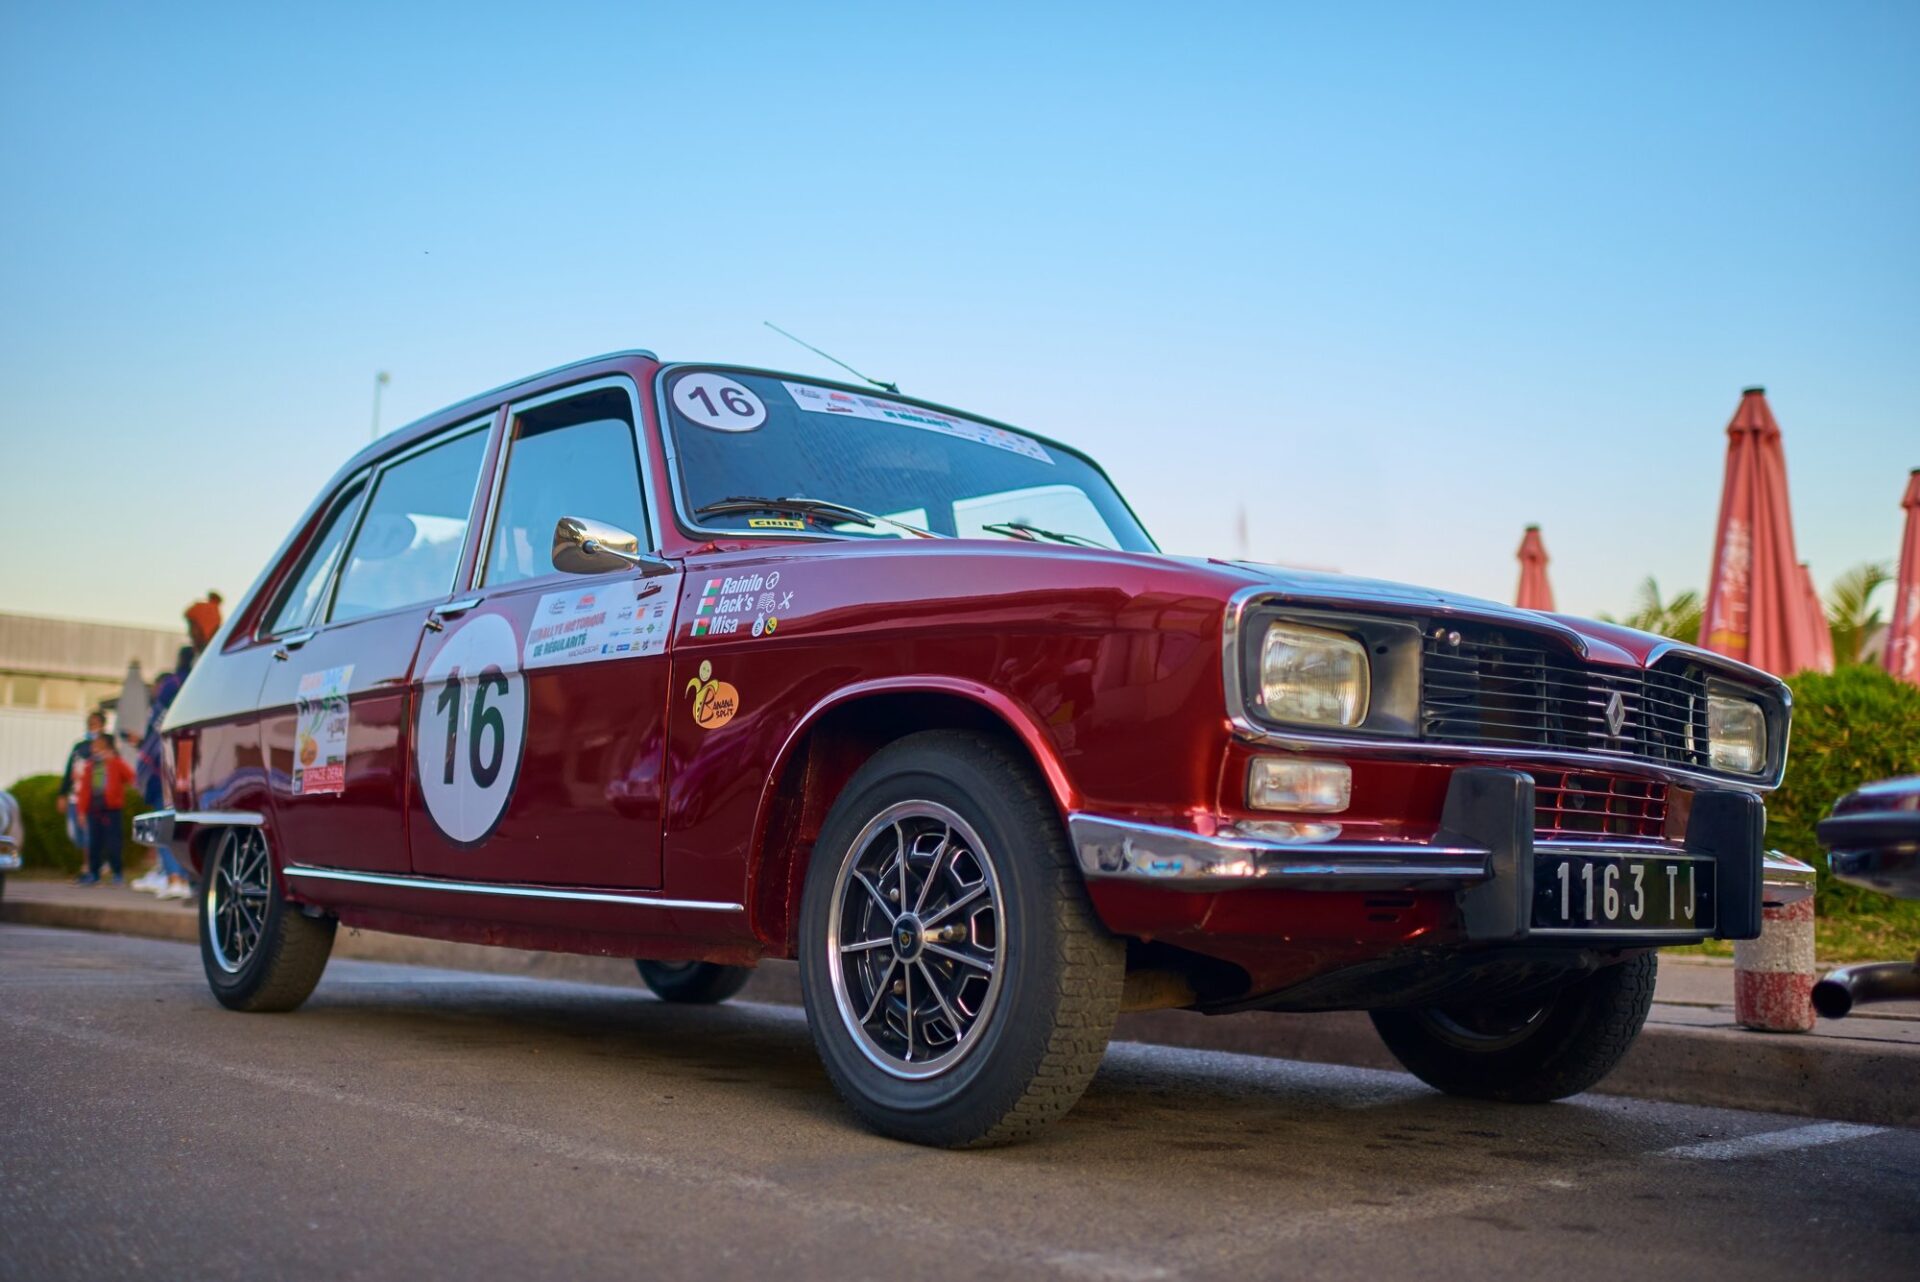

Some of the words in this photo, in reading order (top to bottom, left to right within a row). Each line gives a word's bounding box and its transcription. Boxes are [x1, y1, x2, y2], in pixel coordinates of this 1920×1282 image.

[687, 385, 756, 417] 16
[720, 574, 764, 595] Rainilo
[714, 594, 755, 615] Jack's
[709, 616, 739, 635] Misa
[436, 664, 509, 789] 16
[1557, 862, 1645, 921] 1163
[1666, 865, 1696, 921] TJ
